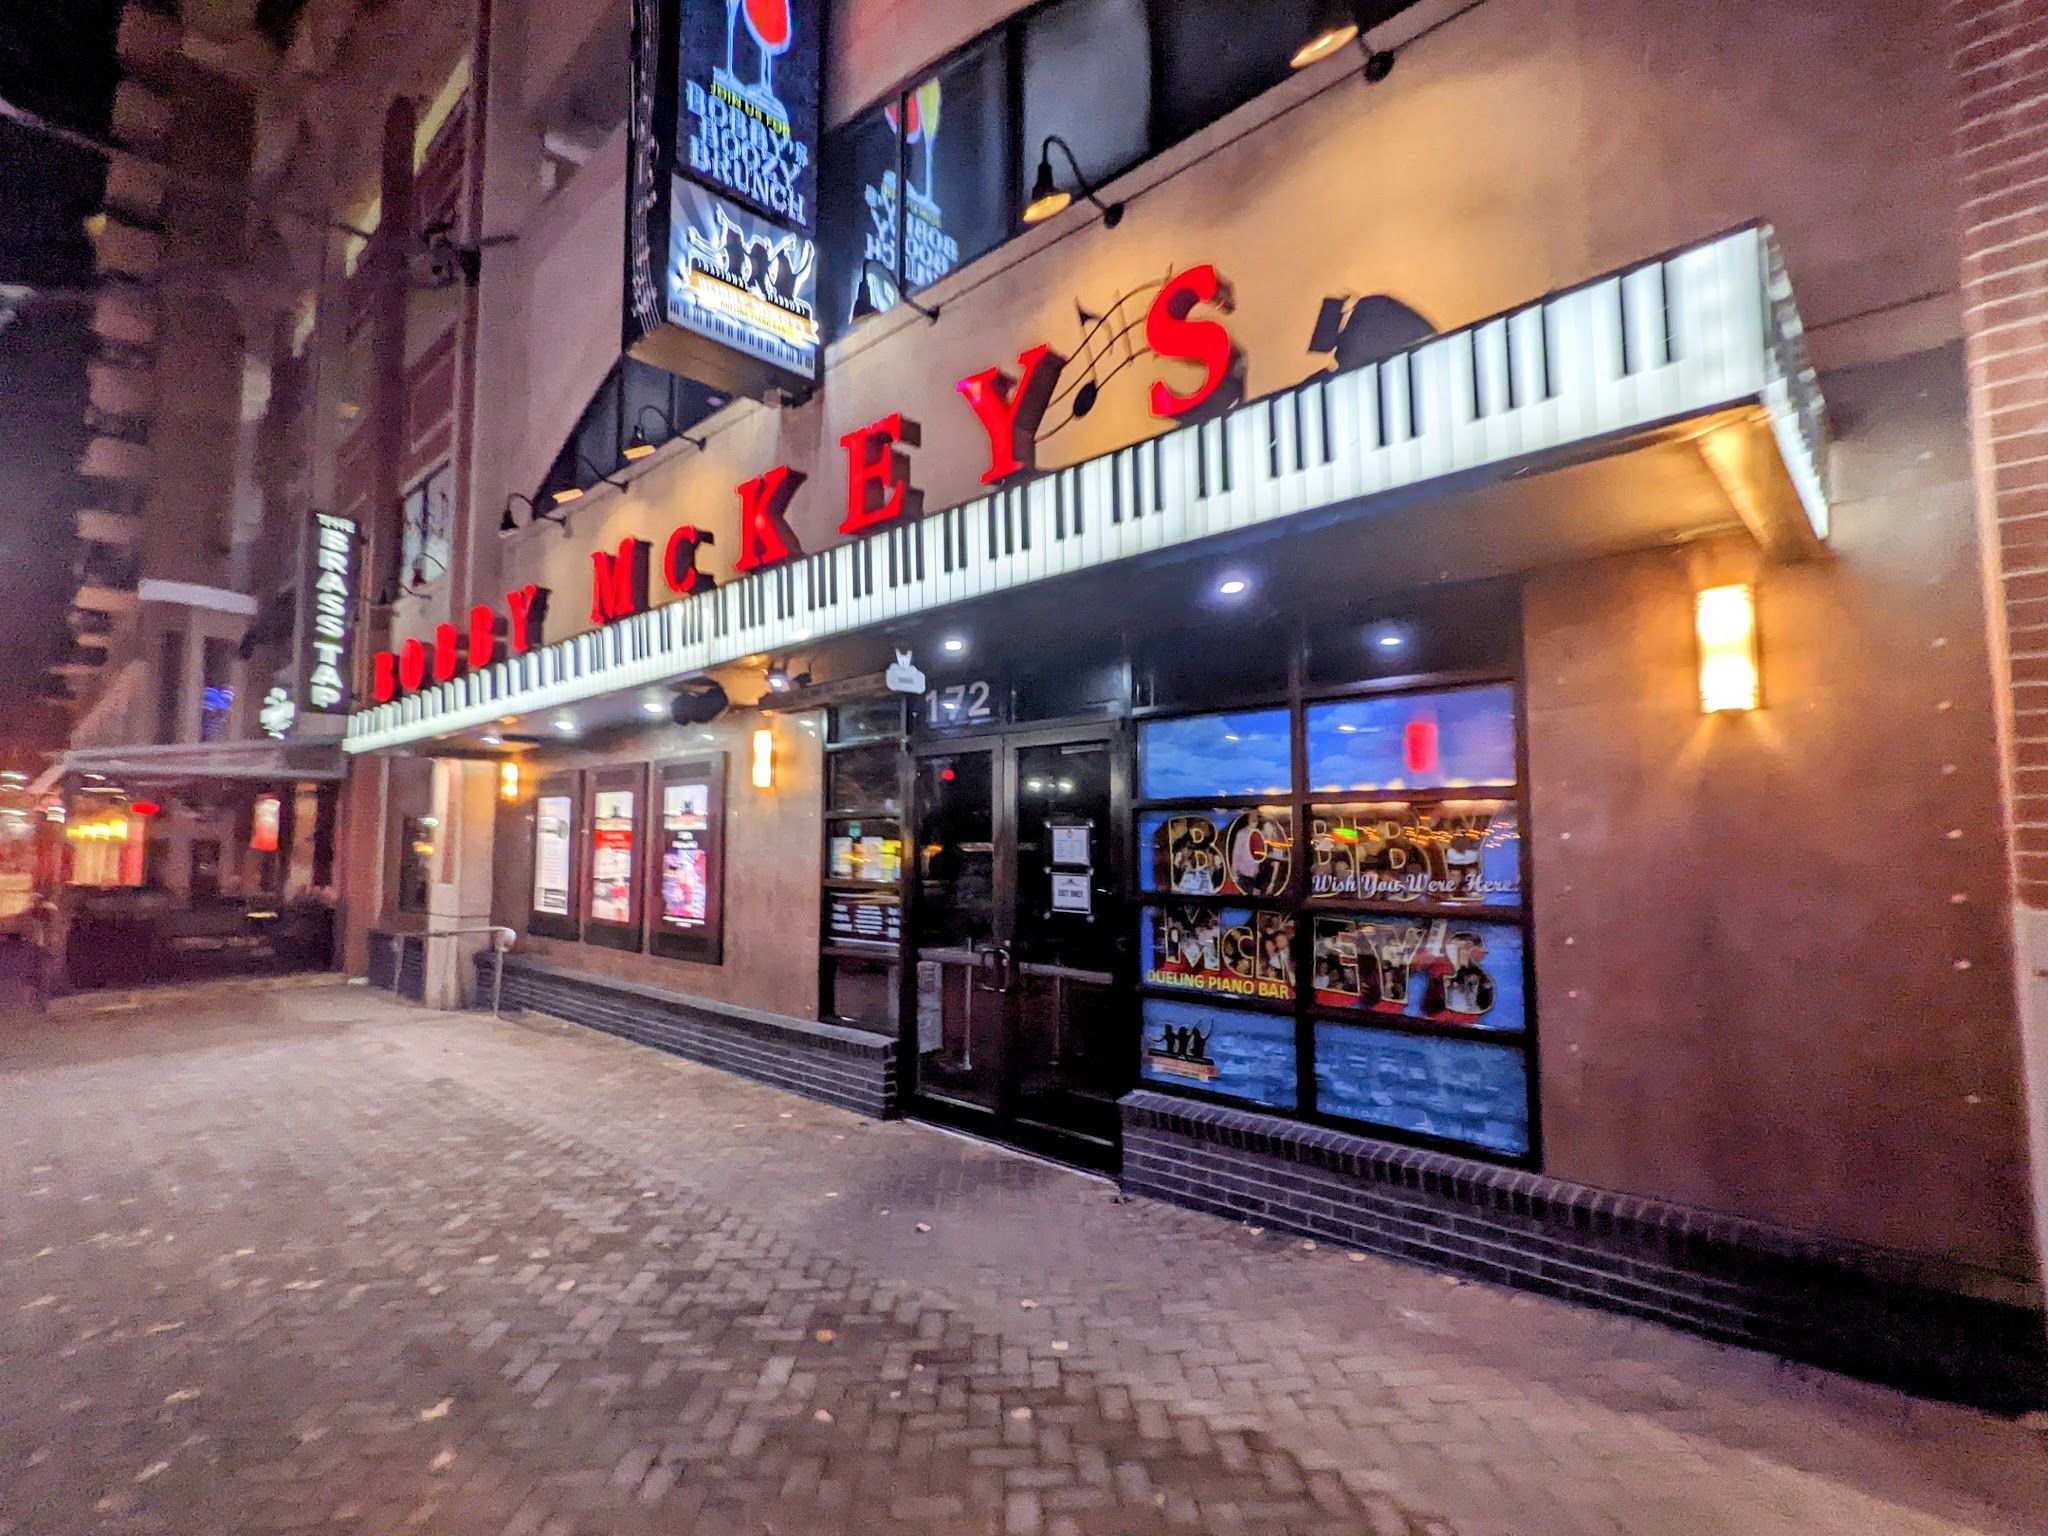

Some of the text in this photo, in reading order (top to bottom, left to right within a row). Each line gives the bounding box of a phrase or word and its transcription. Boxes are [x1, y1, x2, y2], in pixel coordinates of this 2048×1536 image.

[686, 80, 808, 168] BOBBY'S
[711, 83, 741, 109] JOIN
[745, 101, 762, 121] US
[689, 134, 807, 226] BRUNCH
[699, 115, 800, 186] BOOZY
[315, 527, 349, 638] BRASS
[310, 641, 344, 708] TAP
[374, 584, 537, 702] BOBBY
[925, 680, 991, 723] 172
[1312, 873, 1357, 893] Wish
[1361, 873, 1402, 900] You
[1406, 873, 1457, 893] Were
[1146, 969, 1290, 999] DUELING PIANO BAR
